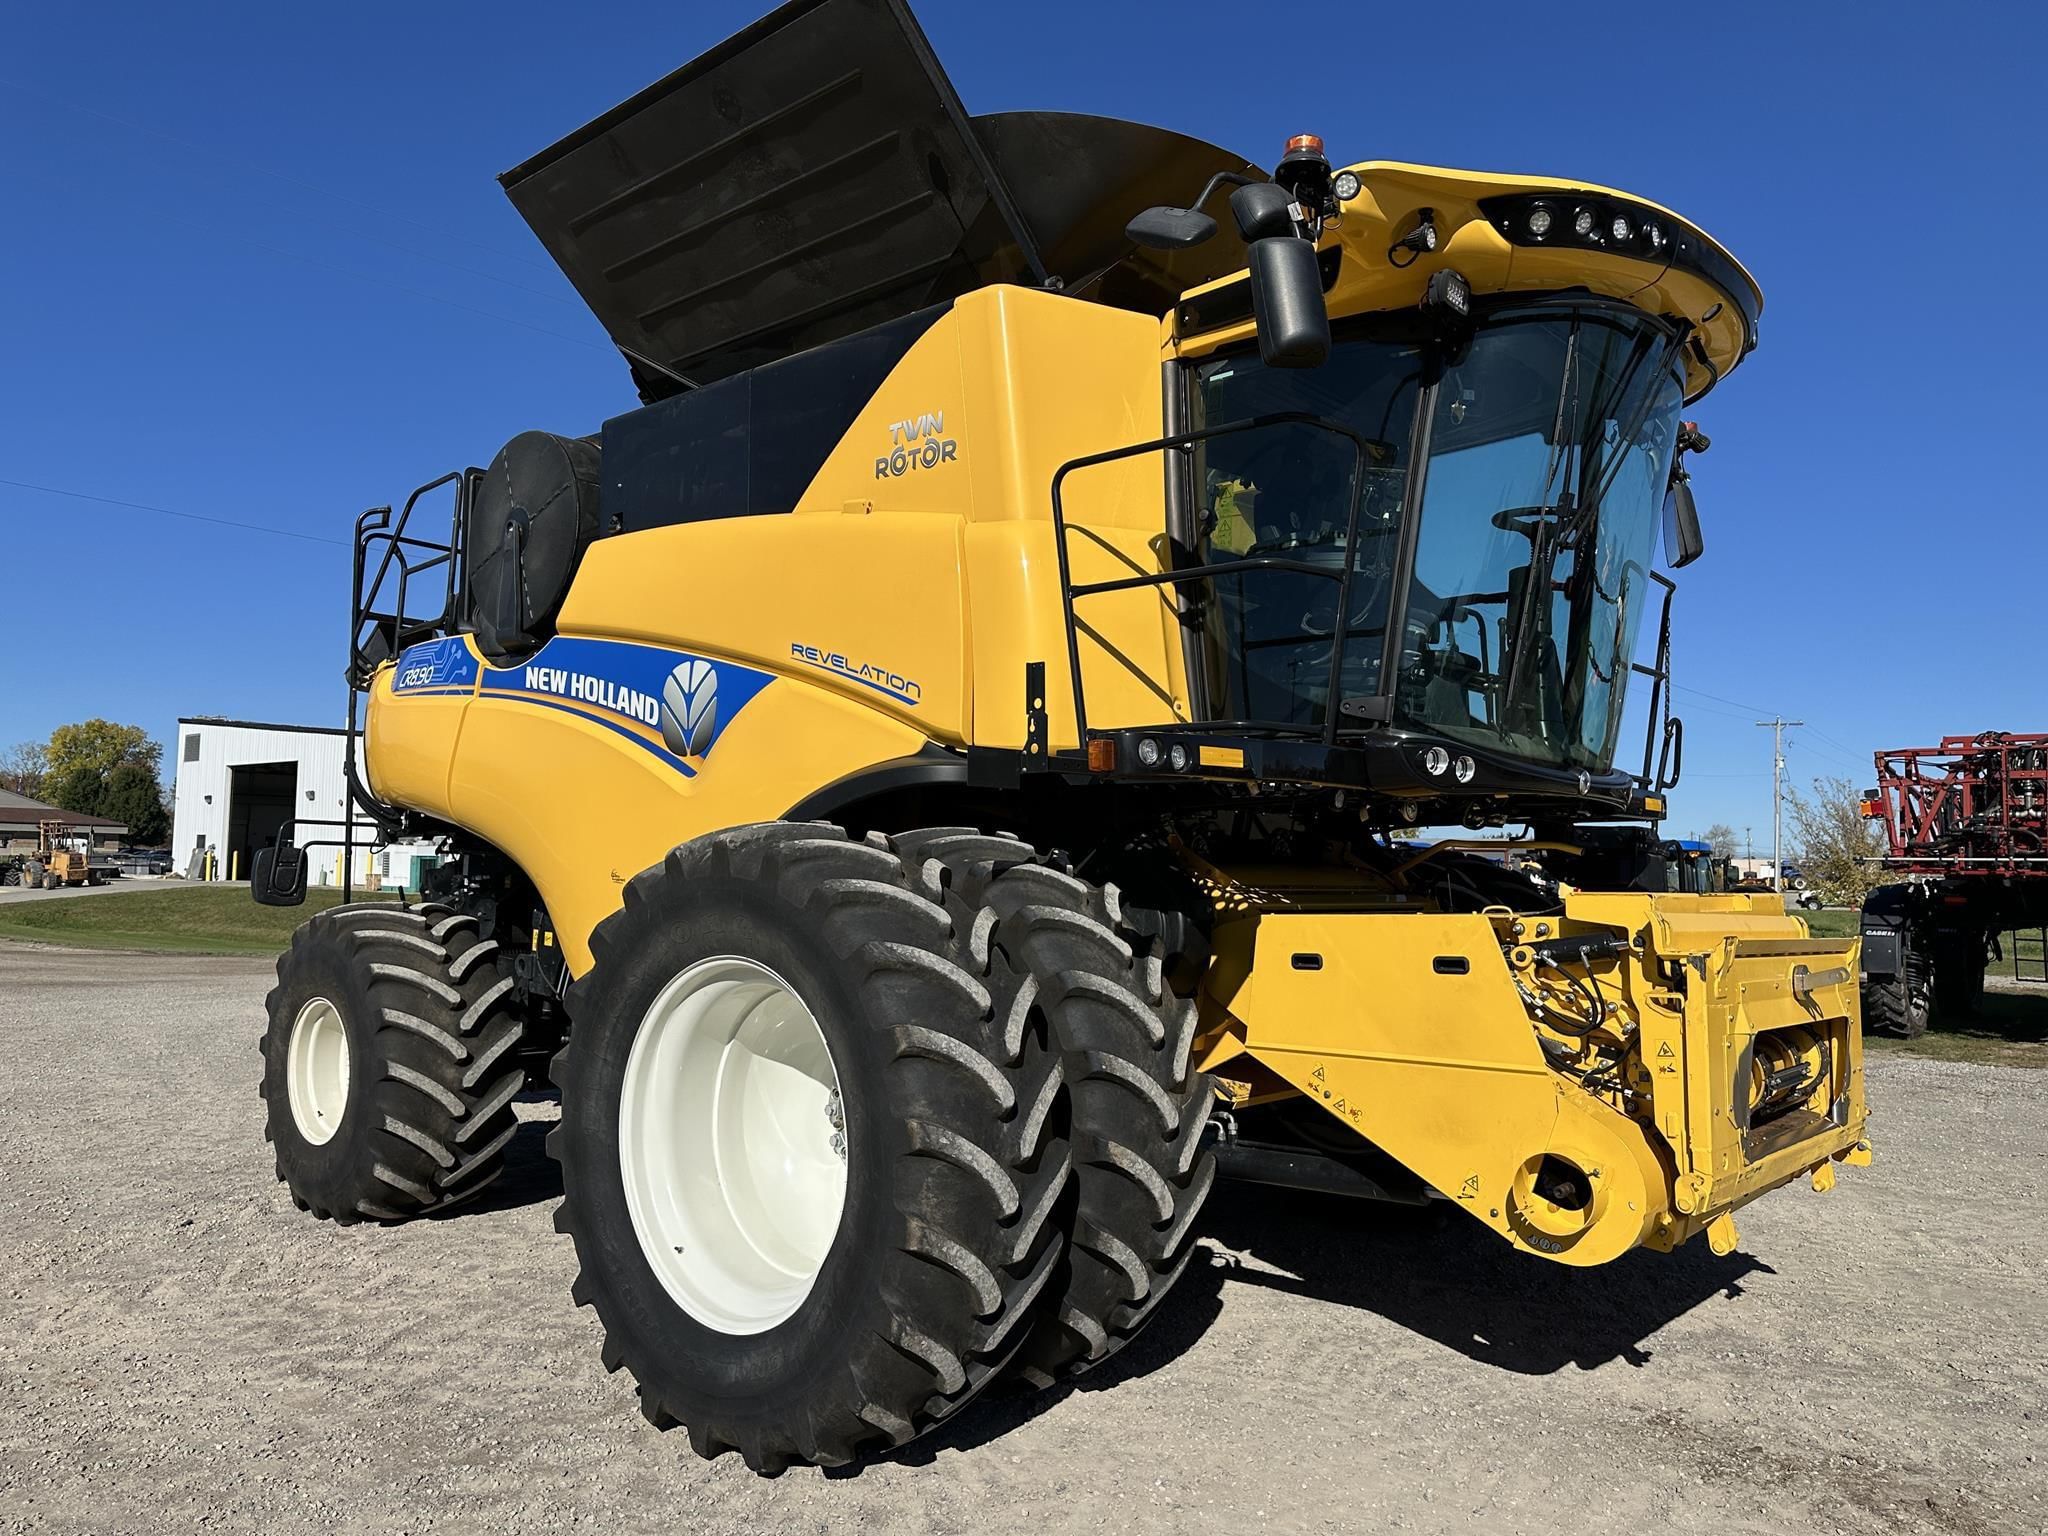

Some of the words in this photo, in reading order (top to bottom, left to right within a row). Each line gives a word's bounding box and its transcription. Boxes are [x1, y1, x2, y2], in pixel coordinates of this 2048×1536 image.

[889, 410, 943, 445] TWIN
[875, 437, 957, 480] ROTOR
[791, 643, 921, 698] REVELATION
[525, 666, 567, 694] NEW
[570, 672, 659, 726] HOLLAND
